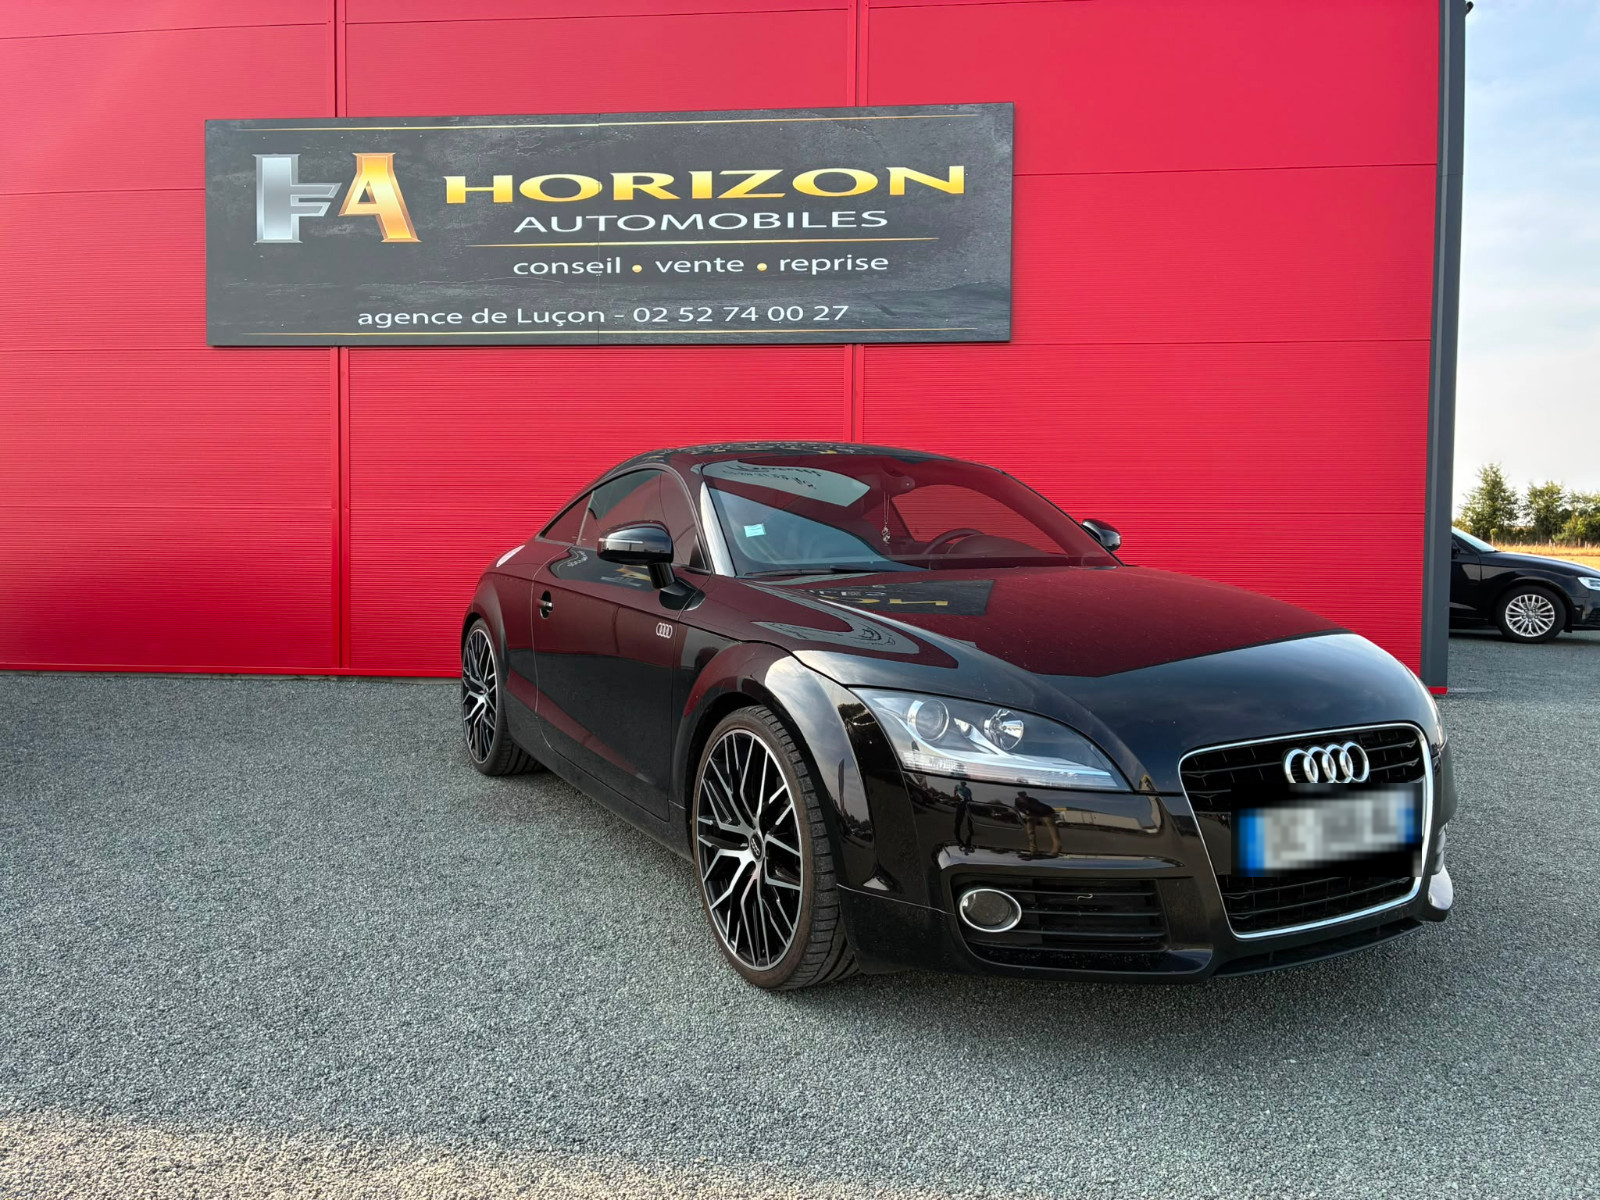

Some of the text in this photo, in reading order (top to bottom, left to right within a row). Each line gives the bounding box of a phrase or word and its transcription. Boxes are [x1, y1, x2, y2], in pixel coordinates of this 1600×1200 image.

[444, 165, 965, 204] HORIZON
[513, 210, 889, 234] AUTOMOBILES
[512, 254, 889, 276] conseil vente reprise
[357, 311, 463, 328] agence
[471, 307, 508, 325] de
[516, 307, 606, 328] Luçon
[633, 307, 669, 323] 02
[678, 307, 714, 323] 52
[723, 306, 760, 322] 74
[767, 306, 805, 322] 00
[813, 305, 850, 321] 27
